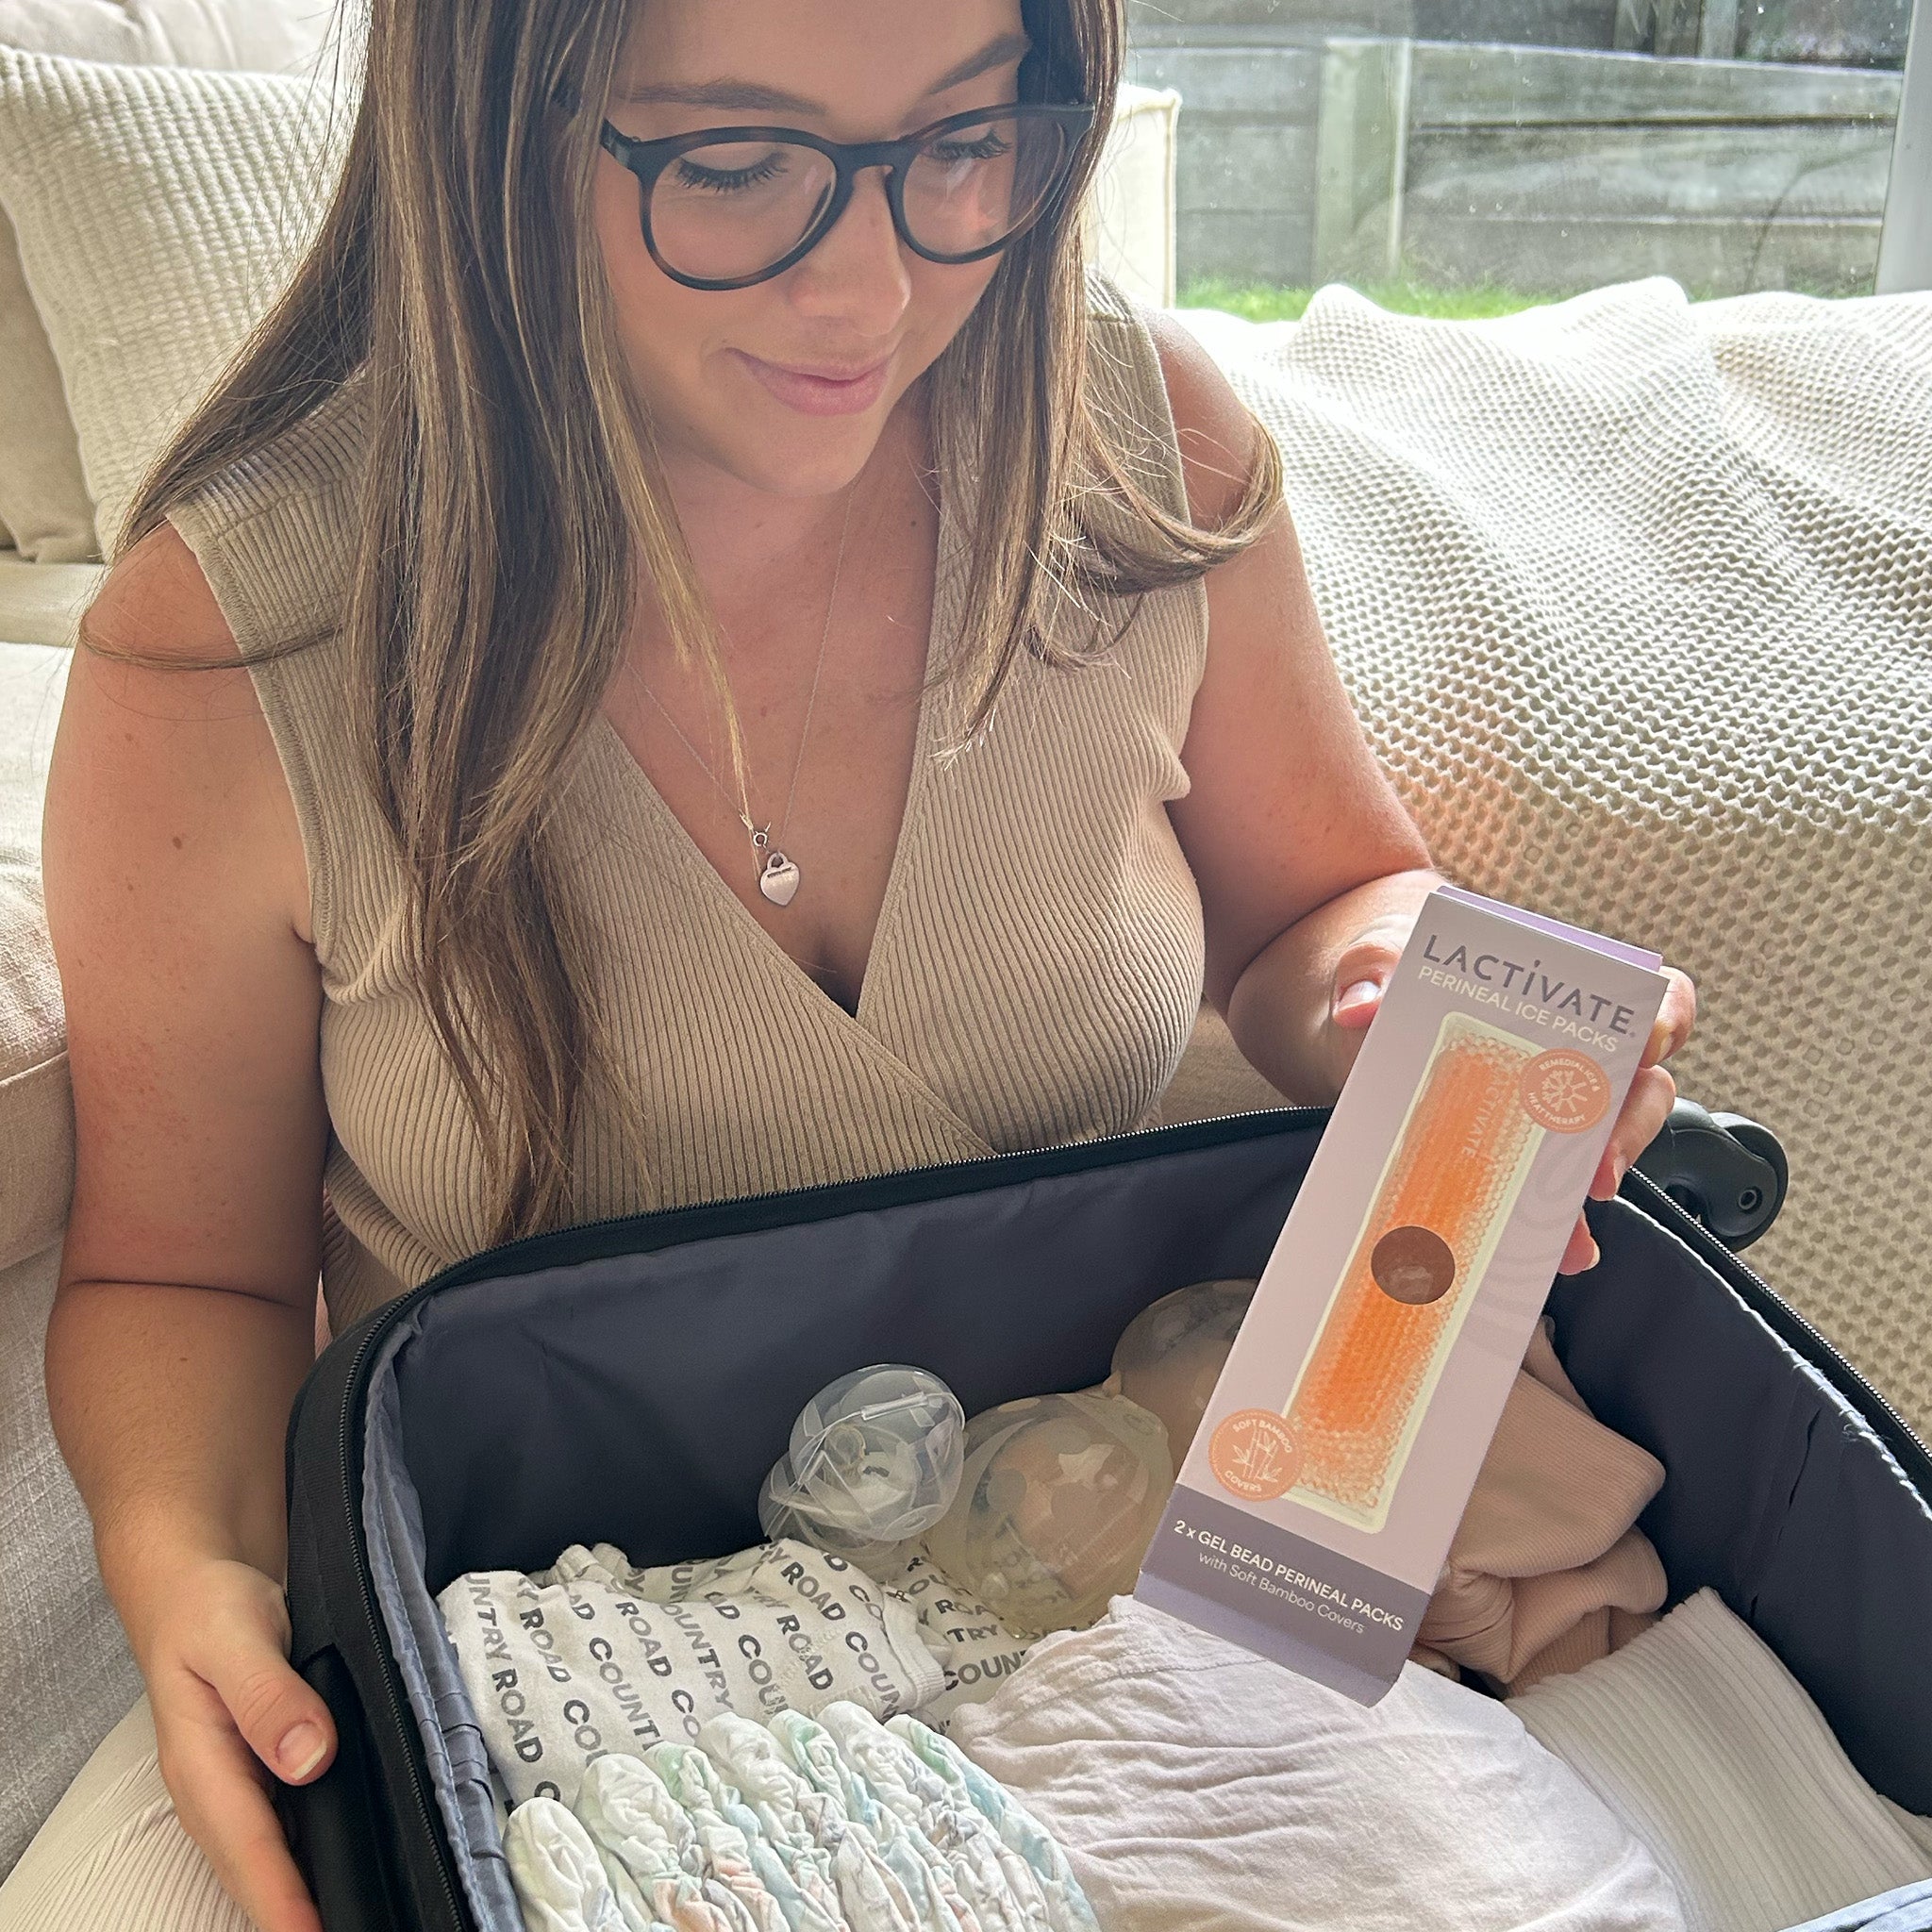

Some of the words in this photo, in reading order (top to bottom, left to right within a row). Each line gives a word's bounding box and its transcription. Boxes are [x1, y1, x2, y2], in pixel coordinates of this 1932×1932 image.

[1418, 965, 1511, 1012] PERINEAL
[1515, 1001, 1552, 1026] ICE
[1552, 1016, 1620, 1053] PACKS
[1528, 1091, 1546, 1113] HEAT
[1544, 1111, 1586, 1125] THERAPY
[1539, 1058, 1585, 1072] REMEDIAL
[1583, 1069, 1598, 1085] ICE
[1232, 1419, 1257, 1433] SOFT
[1258, 1420, 1292, 1453] BAMBOO
[1224, 1470, 1262, 1492] COVERS
[780, 1561, 846, 1621] ROAD
[1174, 1520, 1186, 1535] 2
[1186, 1527, 1194, 1540] x
[1198, 1530, 1227, 1554] GEL
[1230, 1543, 1274, 1574] BEAD
[1274, 1564, 1348, 1607] PERINEAL
[1351, 1597, 1405, 1632] PACKS
[1199, 1552, 1227, 1574] with
[1228, 1564, 1257, 1588] Soft
[1258, 1577, 1315, 1612] Bamboo
[1317, 1603, 1366, 1635] Covers
[520, 1607, 572, 1683] ROAD
[615, 1602, 673, 1676] ROAD
[776, 1614, 834, 1690] ROAD
[491, 1668, 543, 1763] ROAD
